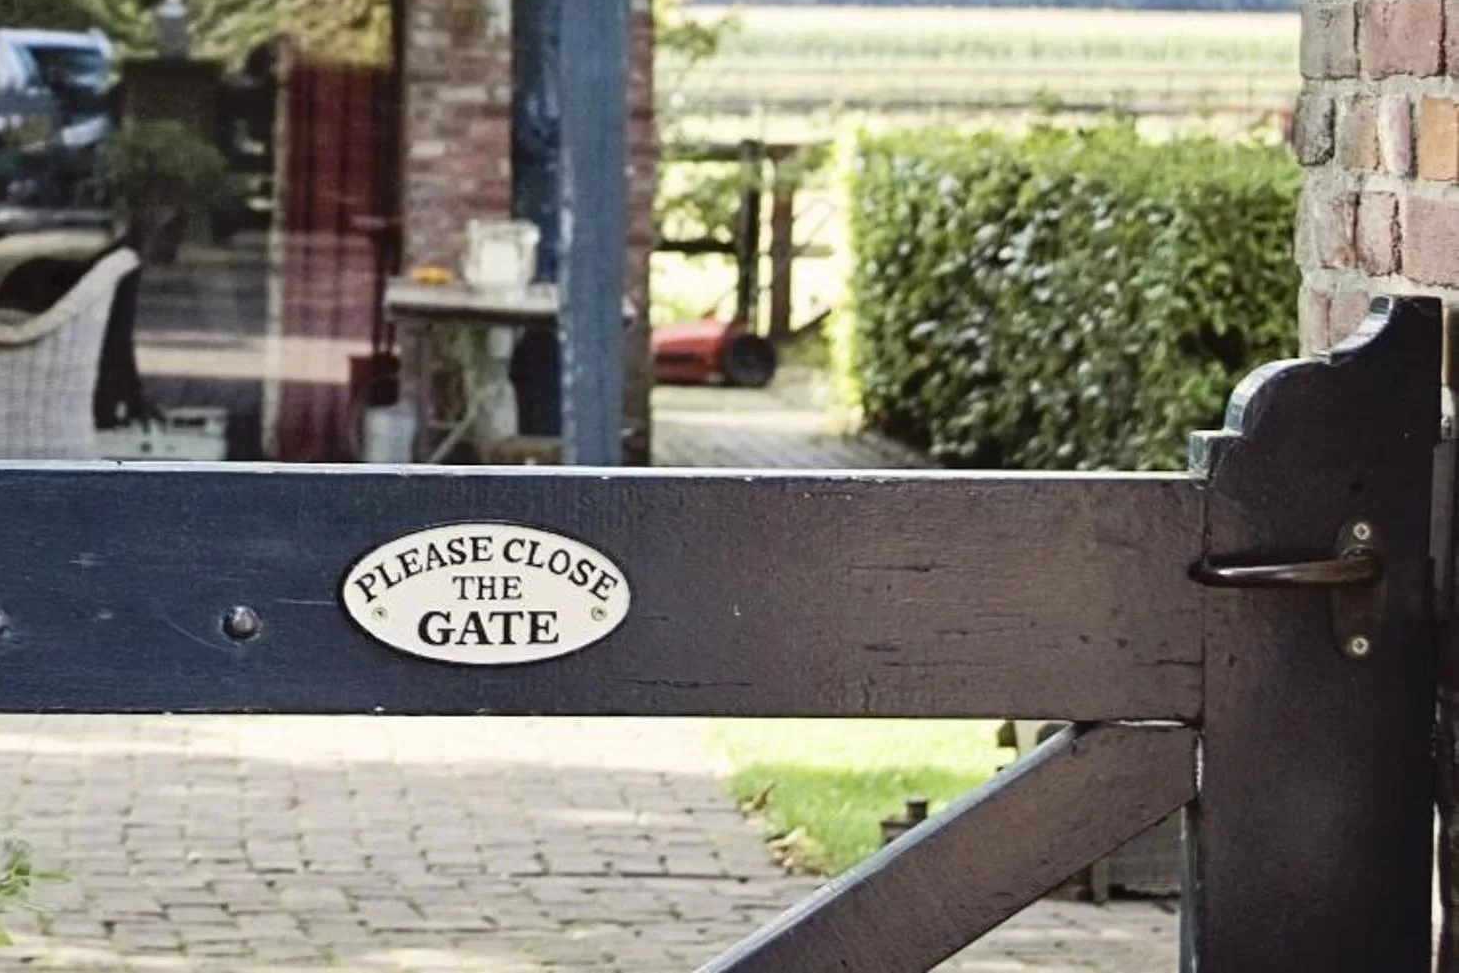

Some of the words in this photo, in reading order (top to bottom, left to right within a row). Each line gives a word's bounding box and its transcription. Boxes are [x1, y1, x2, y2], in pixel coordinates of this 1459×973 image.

[354, 536, 493, 603] PLEASE
[503, 538, 618, 602] CLOSE
[452, 575, 522, 601] THE
[418, 610, 560, 645] GATE
